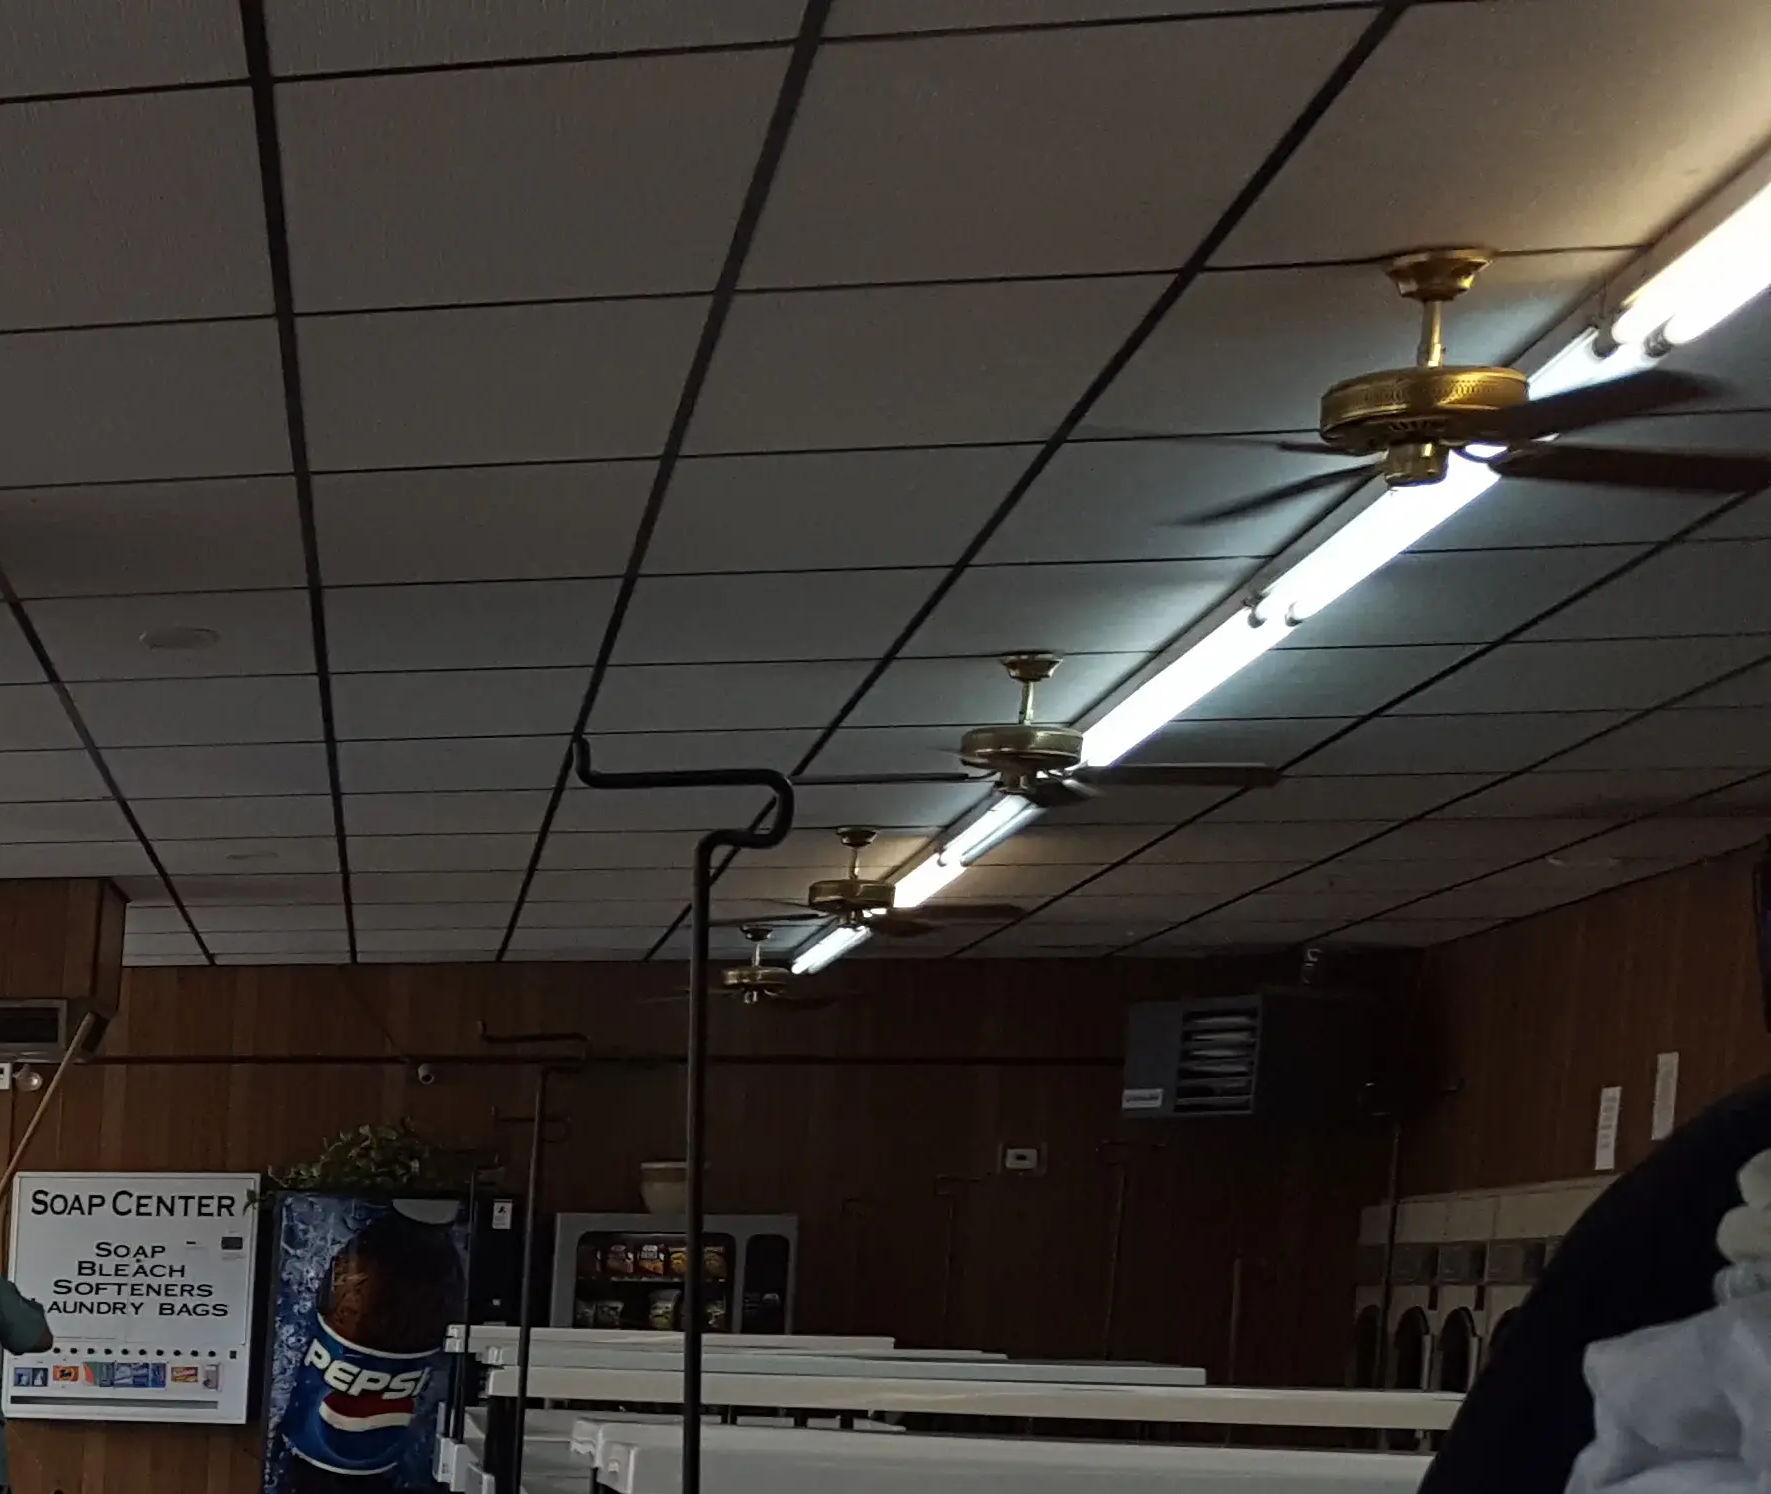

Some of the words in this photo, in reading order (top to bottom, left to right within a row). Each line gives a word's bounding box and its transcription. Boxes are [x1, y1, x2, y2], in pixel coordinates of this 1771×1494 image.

[45, 1301, 144, 1315] AUNDRY
[158, 1303, 229, 1317] BAGS
[304, 1338, 433, 1400] PEPSI
